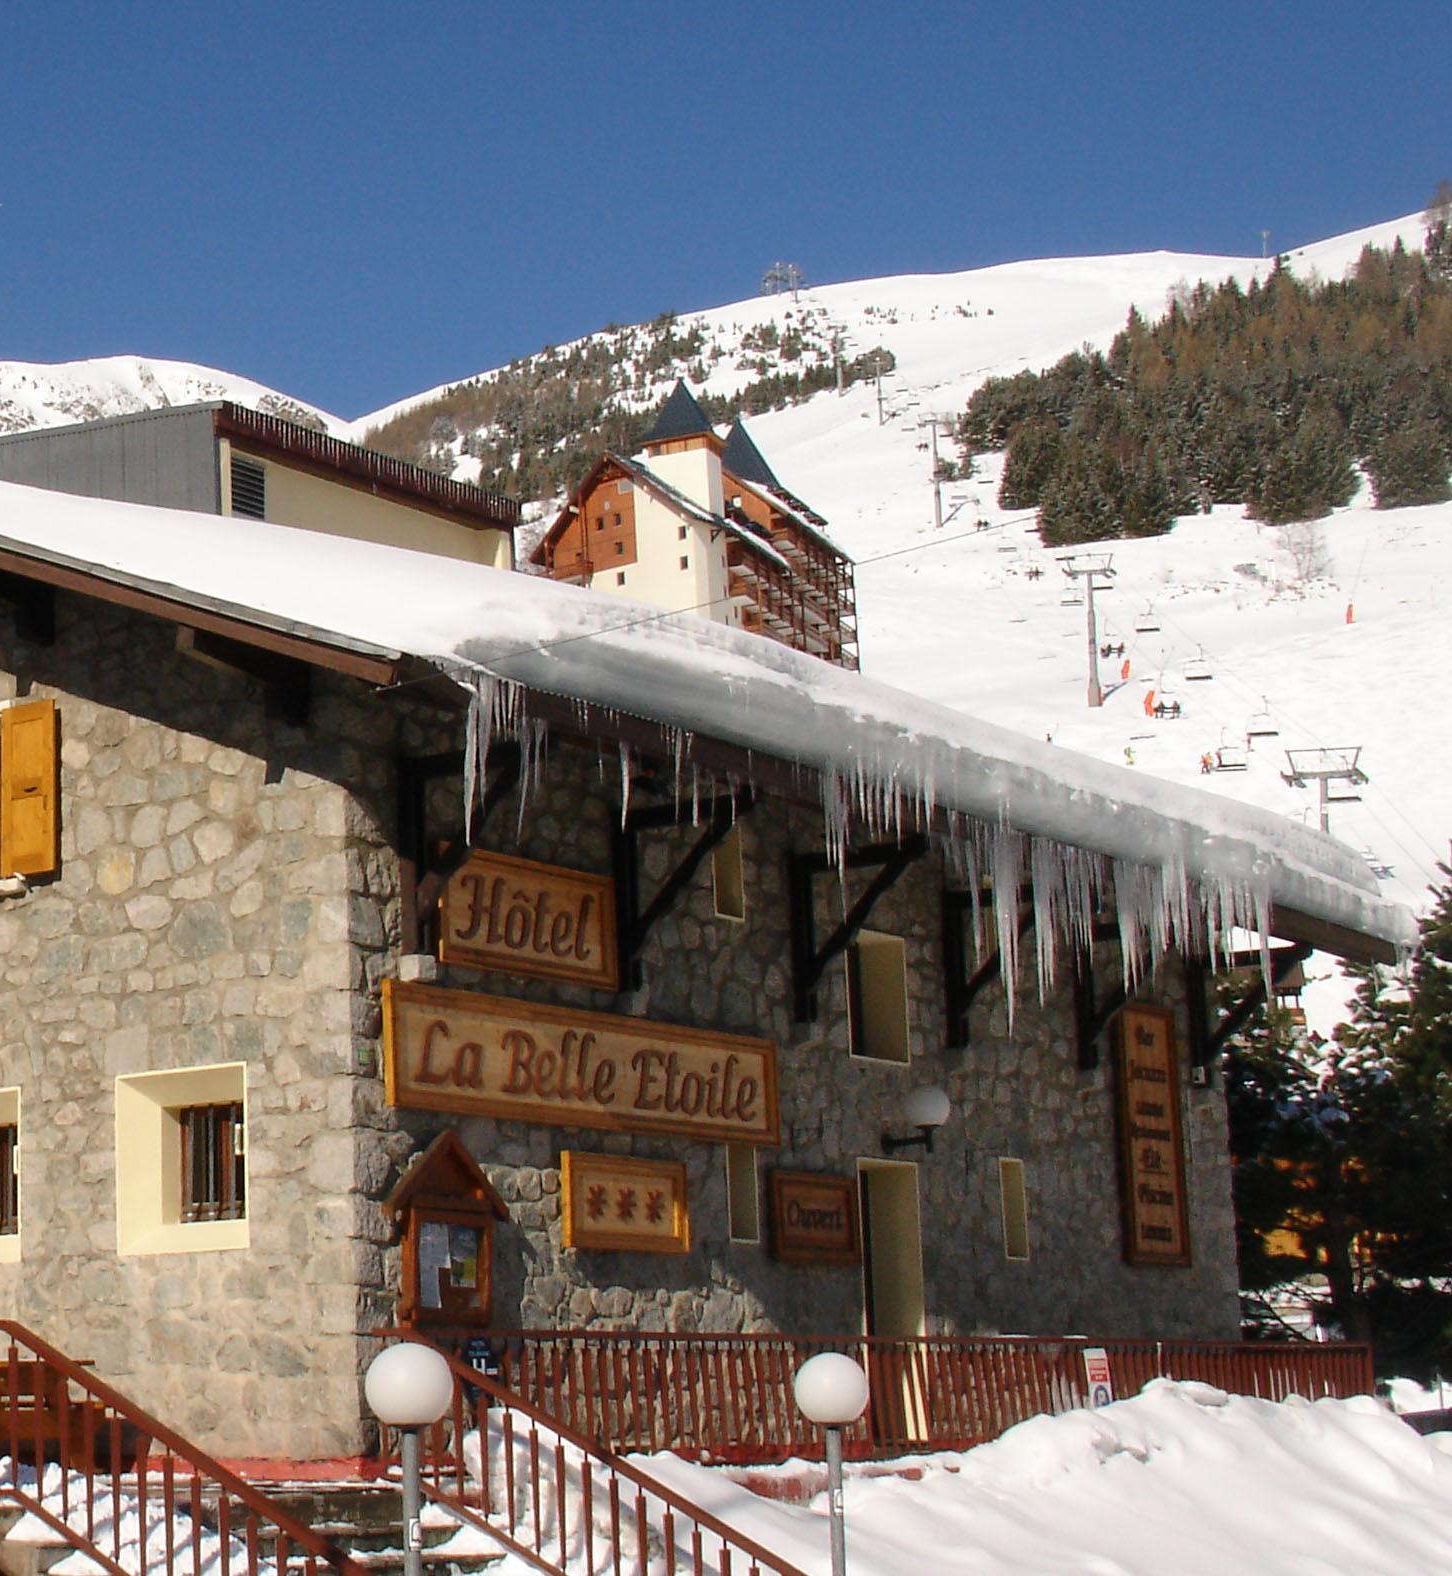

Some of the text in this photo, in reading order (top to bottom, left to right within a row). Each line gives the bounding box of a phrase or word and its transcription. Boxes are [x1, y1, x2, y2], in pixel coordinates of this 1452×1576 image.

[455, 873, 595, 961] Hôtel
[414, 1020, 757, 1122] La Belle Etoile
[787, 1200, 842, 1230] Ouvert
